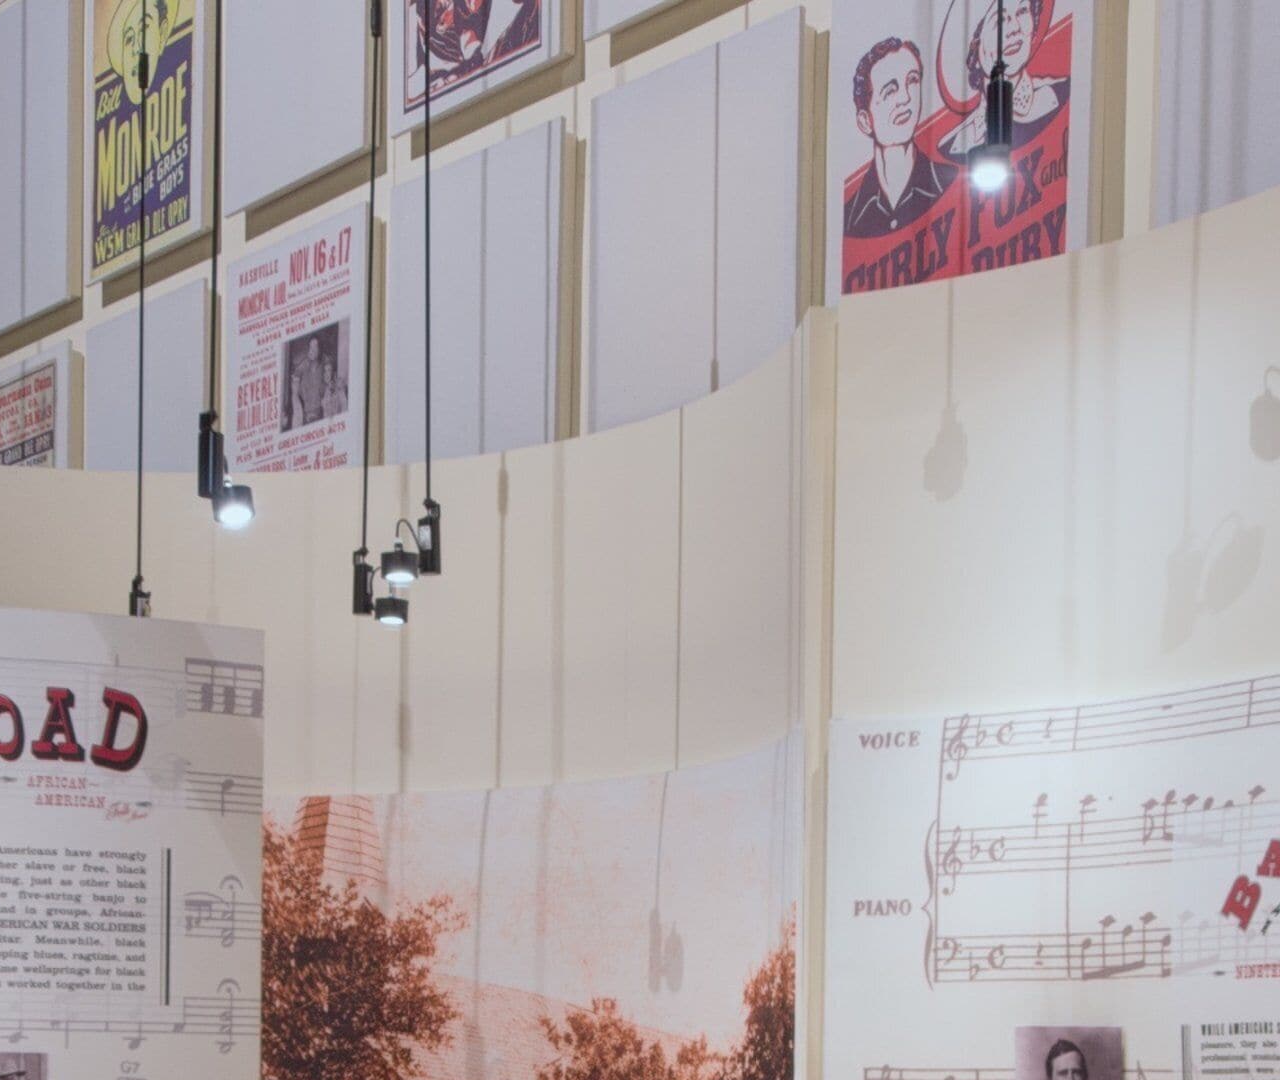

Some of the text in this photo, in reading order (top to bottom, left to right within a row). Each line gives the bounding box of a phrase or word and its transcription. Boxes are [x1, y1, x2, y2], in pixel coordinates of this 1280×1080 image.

[96, 83, 122, 121] Bill
[97, 60, 187, 224] MONROE
[157, 137, 188, 182] GRASS
[160, 162, 184, 201] BOYS
[289, 246, 310, 286] NOV.
[313, 238, 326, 276] 16
[338, 226, 352, 266] 17
[240, 260, 279, 288] NASHVILLE
[237, 374, 278, 409] BEVERLY
[859, 730, 921, 750] VOICE
[34, 793, 106, 809] AMERICAN
[65, 847, 93, 857] have
[99, 849, 147, 862] strongly
[92, 892, 126, 905] banjo
[853, 898, 913, 918] PIANO
[52, 919, 81, 931] WAR
[83, 921, 147, 934] SOLDIERS
[56, 980, 107, 993] together
